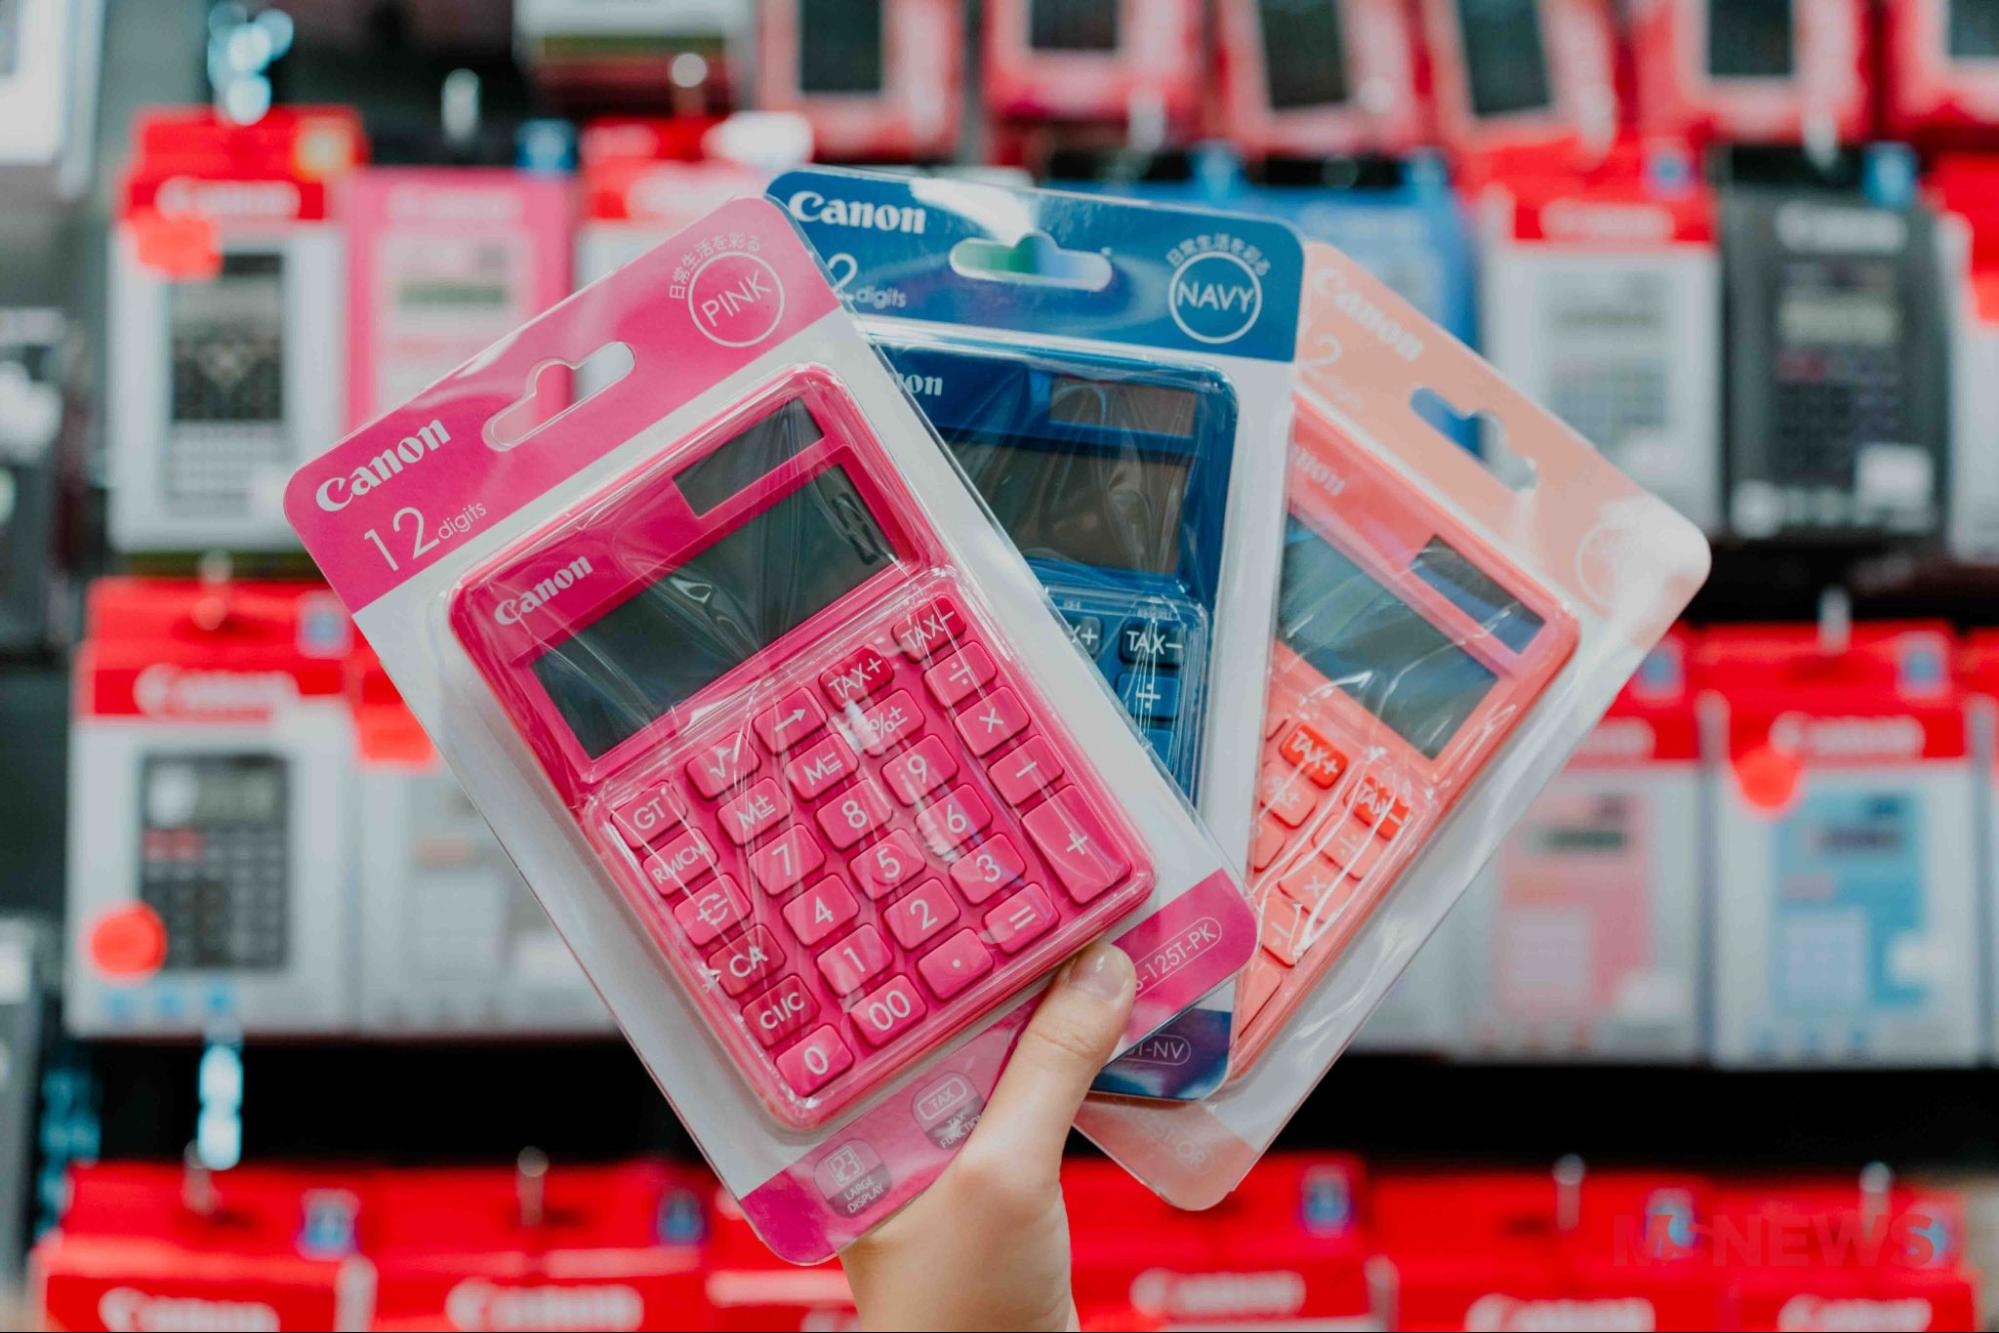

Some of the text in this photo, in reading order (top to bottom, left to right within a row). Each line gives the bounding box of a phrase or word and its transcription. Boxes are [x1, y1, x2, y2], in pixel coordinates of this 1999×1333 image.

[789, 190, 926, 235] Canon
[701, 270, 772, 328] PINK
[855, 285, 908, 311] digits
[1177, 280, 1254, 315] NAVY
[315, 419, 451, 512] Canon
[364, 502, 488, 572] 12 digits
[494, 555, 594, 626] Canon
[828, 658, 882, 699] TAX+
[906, 754, 929, 786] 9
[632, 797, 666, 830] GT
[841, 800, 868, 830] 8
[946, 803, 968, 835] 6
[770, 842, 793, 877] 7
[876, 846, 901, 879] 5
[976, 854, 1001, 884] 3
[814, 895, 835, 925] 4
[909, 899, 938, 930] 2
[728, 946, 770, 979] CA
[843, 947, 867, 974] 1
[867, 989, 911, 1032] 00
[803, 1045, 830, 1076] 0
[933, 1086, 955, 1111] TAX
[844, 1175, 875, 1201] LARGE
[847, 1183, 885, 1215] DISPLAY
